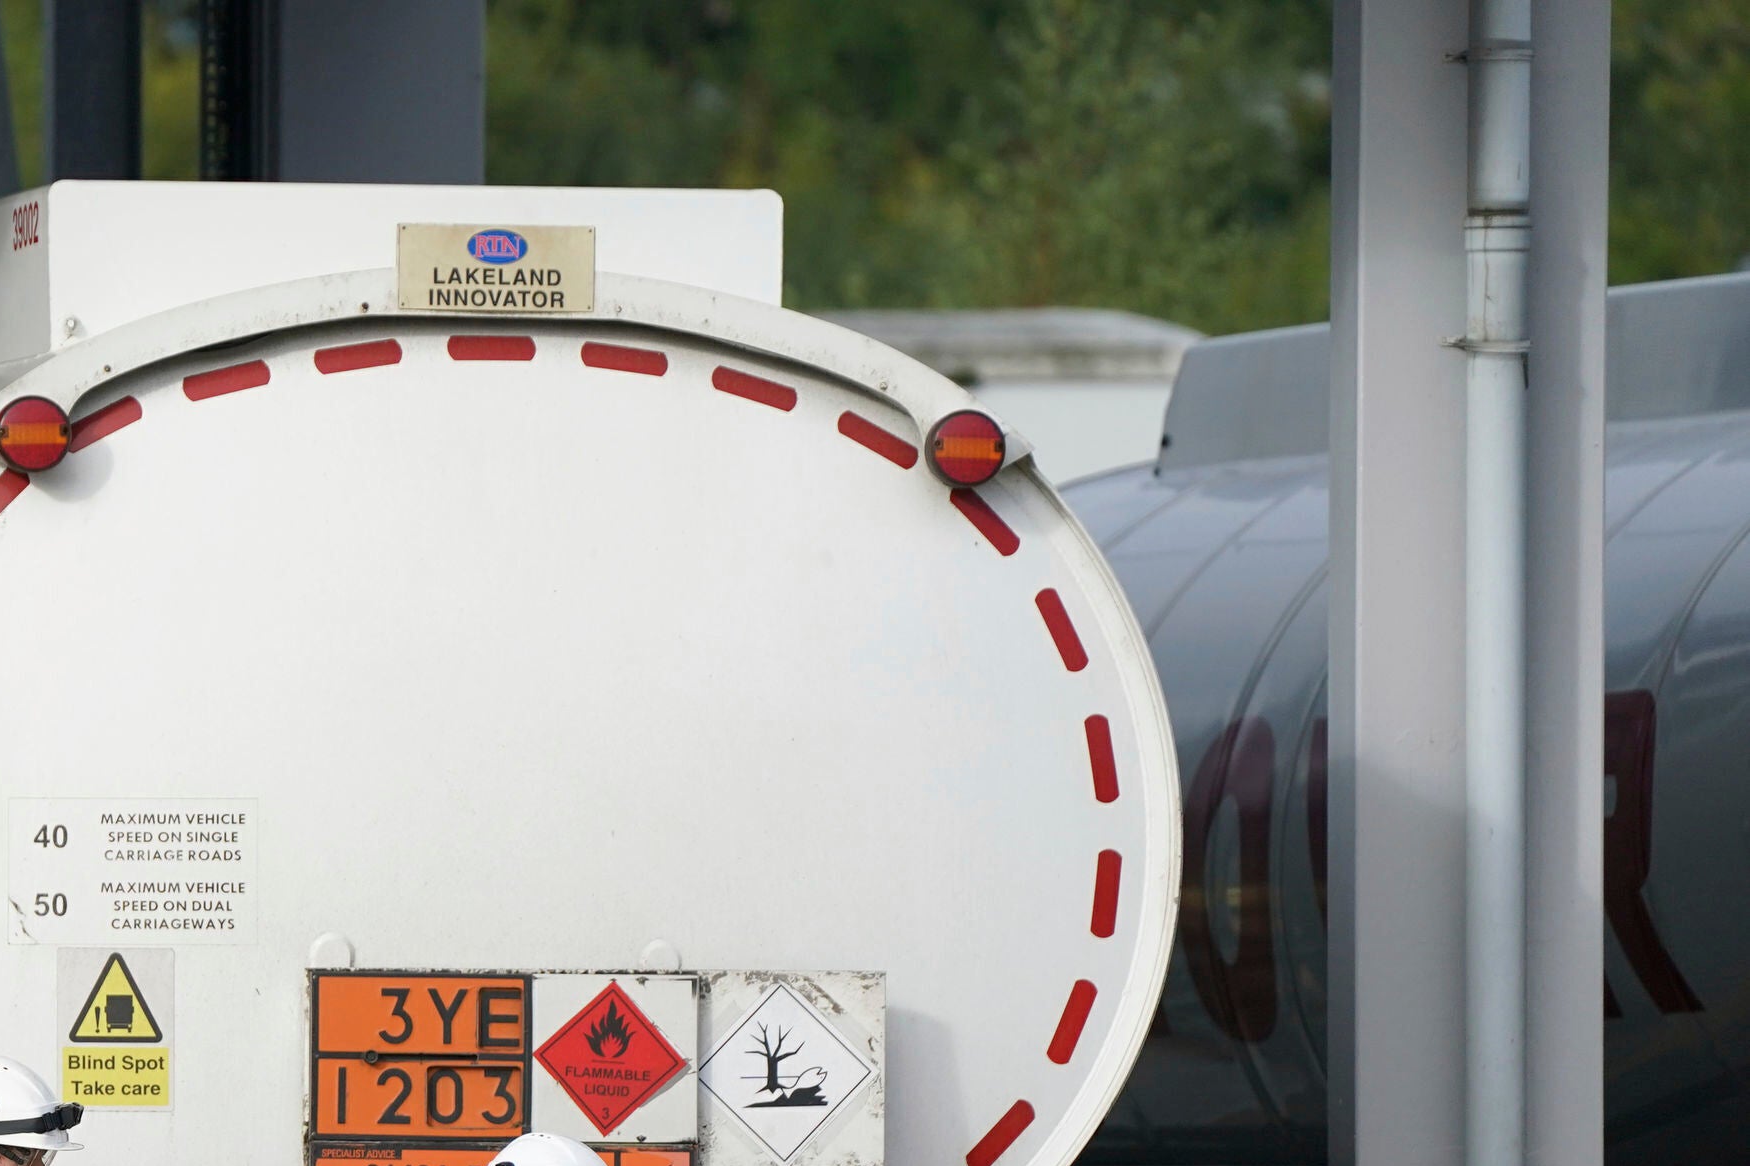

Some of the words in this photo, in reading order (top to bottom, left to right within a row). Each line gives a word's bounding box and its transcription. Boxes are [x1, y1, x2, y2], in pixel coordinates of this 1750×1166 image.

[12, 200, 39, 252] 39002
[433, 267, 562, 287] LAKELAND
[428, 288, 564, 309] INNOVATOR
[100, 813, 181, 825] MAXIMUM
[185, 813, 246, 825] VEHICLE
[33, 824, 68, 848] 40
[108, 831, 153, 843] SPEED
[158, 831, 182, 843] ON
[186, 831, 238, 843] SINGLE
[104, 849, 183, 861] CARRIAGE
[188, 849, 242, 861] ROADS
[100, 882, 181, 894] MAXIMUM
[185, 882, 245, 894] VEHICLE
[34, 892, 68, 917] 50
[113, 900, 158, 912] SPEED
[163, 900, 187, 912] ON
[192, 900, 233, 912] DUAL
[111, 918, 235, 930] CARRIAGEWAYS
[378, 987, 521, 1048] 3YE
[68, 1055, 115, 1070] Blind
[122, 1055, 165, 1074] Spot
[565, 1065, 652, 1081] FLAMMABLE
[71, 1080, 115, 1095] Take
[121, 1083, 161, 1096] care
[337, 1066, 517, 1125] 1203
[584, 1084, 630, 1098] LIQUID
[602, 1107, 610, 1119] 3
[321, 1148, 365, 1159] SPECIALIST
[366, 1149, 396, 1159] ADVICE
